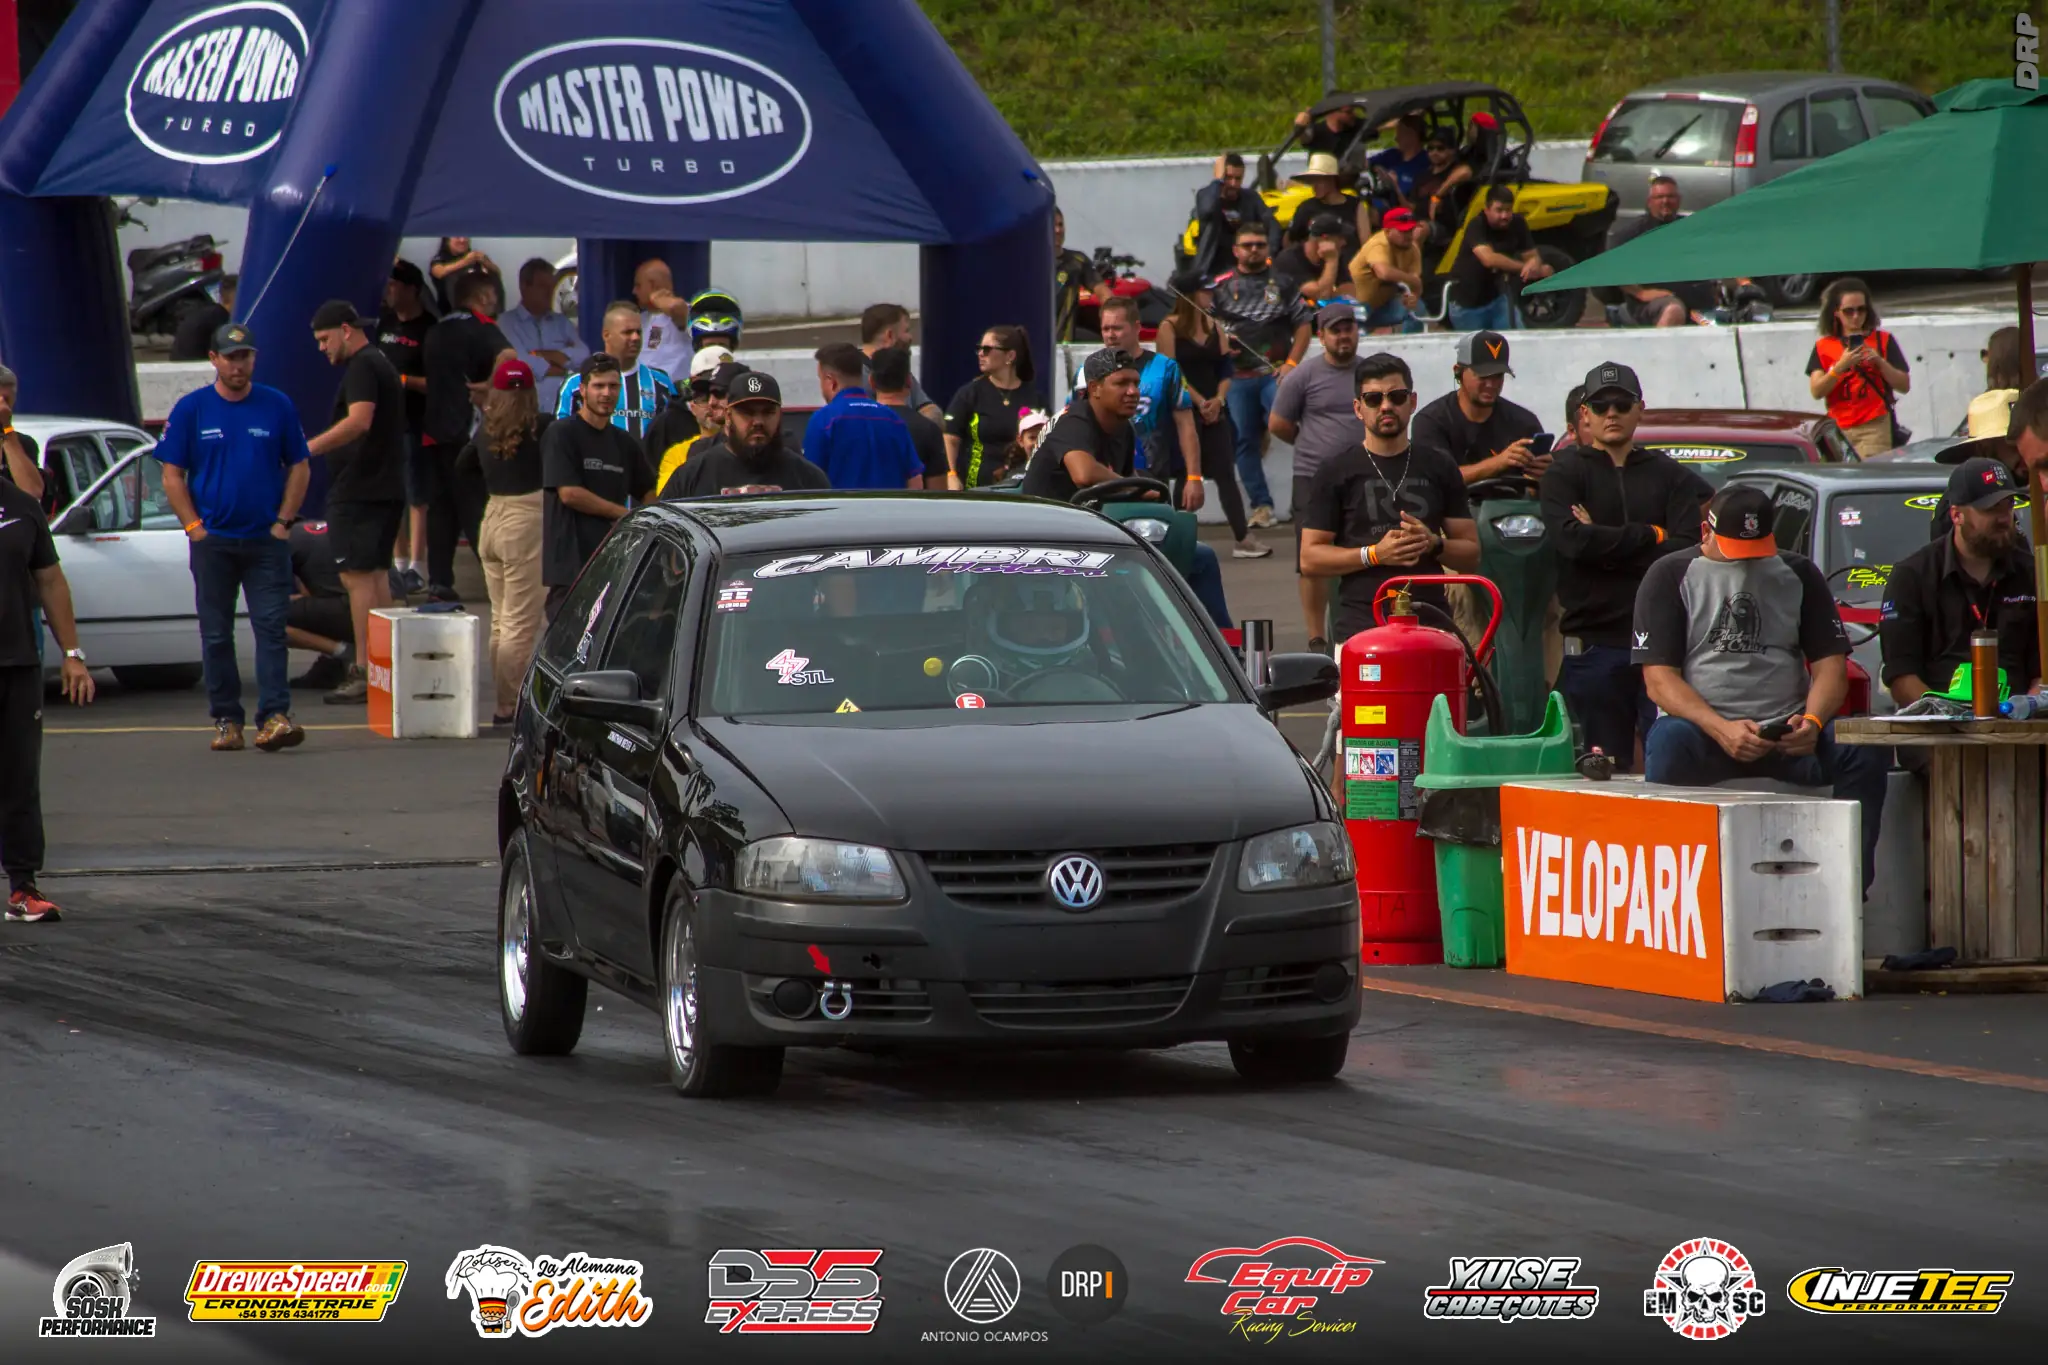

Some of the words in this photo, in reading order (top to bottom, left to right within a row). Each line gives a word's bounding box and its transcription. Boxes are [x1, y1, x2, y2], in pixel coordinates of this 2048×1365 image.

[143, 26, 243, 102] MASTER
[225, 26, 298, 102] POWER
[518, 65, 654, 142] MASTER
[654, 65, 784, 142] POWER
[165, 117, 256, 137] TURBO
[584, 157, 735, 174] TURBO
[753, 546, 1115, 578] CAMBRI
[790, 670, 835, 686] STL
[962, 696, 979, 708] E
[1517, 826, 1708, 959] VELOPARK
